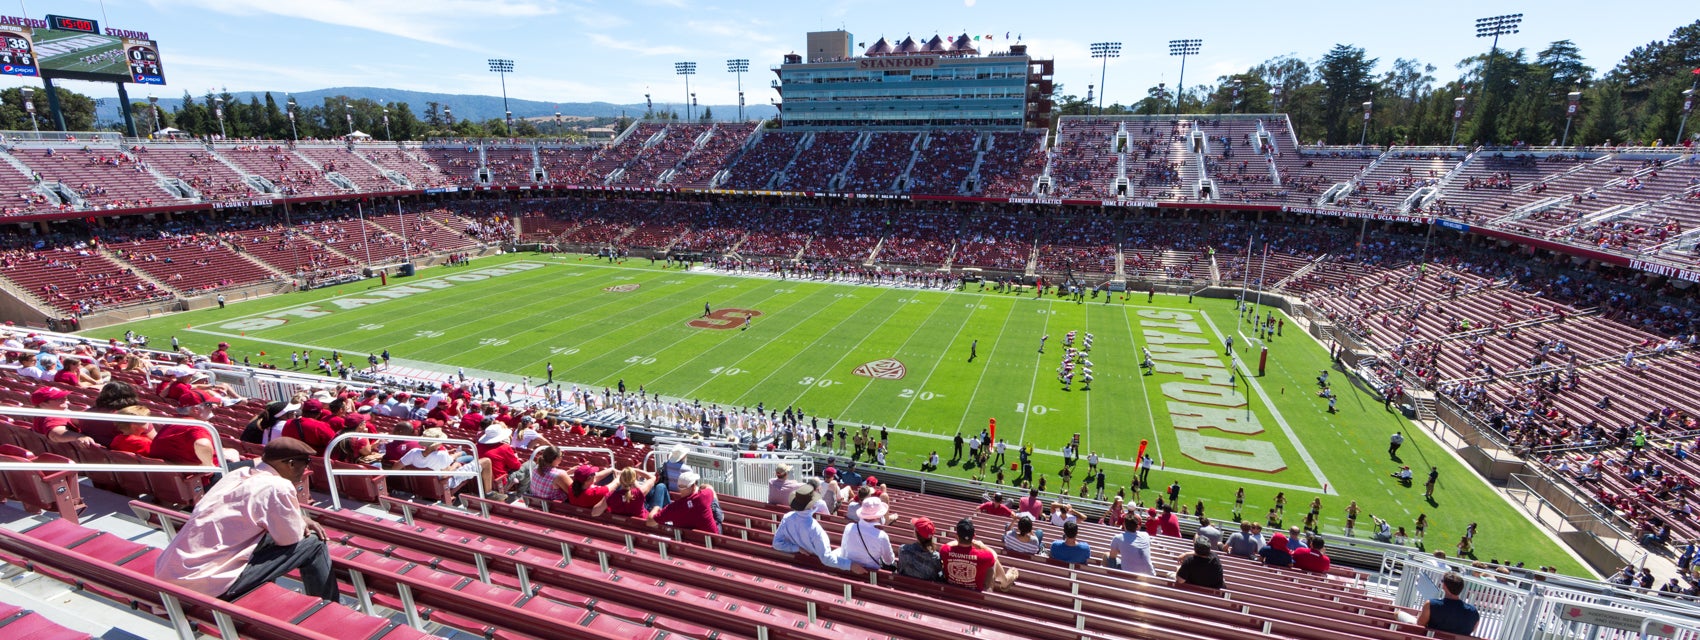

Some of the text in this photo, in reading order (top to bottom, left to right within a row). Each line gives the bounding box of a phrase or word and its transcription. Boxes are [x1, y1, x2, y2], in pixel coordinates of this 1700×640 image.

[61, 18, 91, 31] 15:00
[105, 27, 149, 40] STADIUM
[8, 38, 28, 49] 38
[3, 55, 10, 63] 4
[133, 50, 141, 60] 0
[860, 37, 935, 69] STANFORD
[22, 57, 30, 65] 6
[212, 201, 249, 209] TRI-COUNTY
[1290, 207, 1315, 215] SCHEDULE
[1316, 209, 1341, 217] INCLUDES
[1629, 259, 1677, 277] TRI-COUNTY
[220, 262, 547, 332] STANFORD
[685, 307, 766, 331] S
[624, 356, 657, 365] 50
[709, 366, 742, 376] 40
[798, 376, 833, 388] 30
[897, 388, 934, 401] 20
[1137, 309, 1288, 474] STANFORD
[1015, 402, 1047, 415] 10
[948, 551, 977, 560] VOLUNTEER
